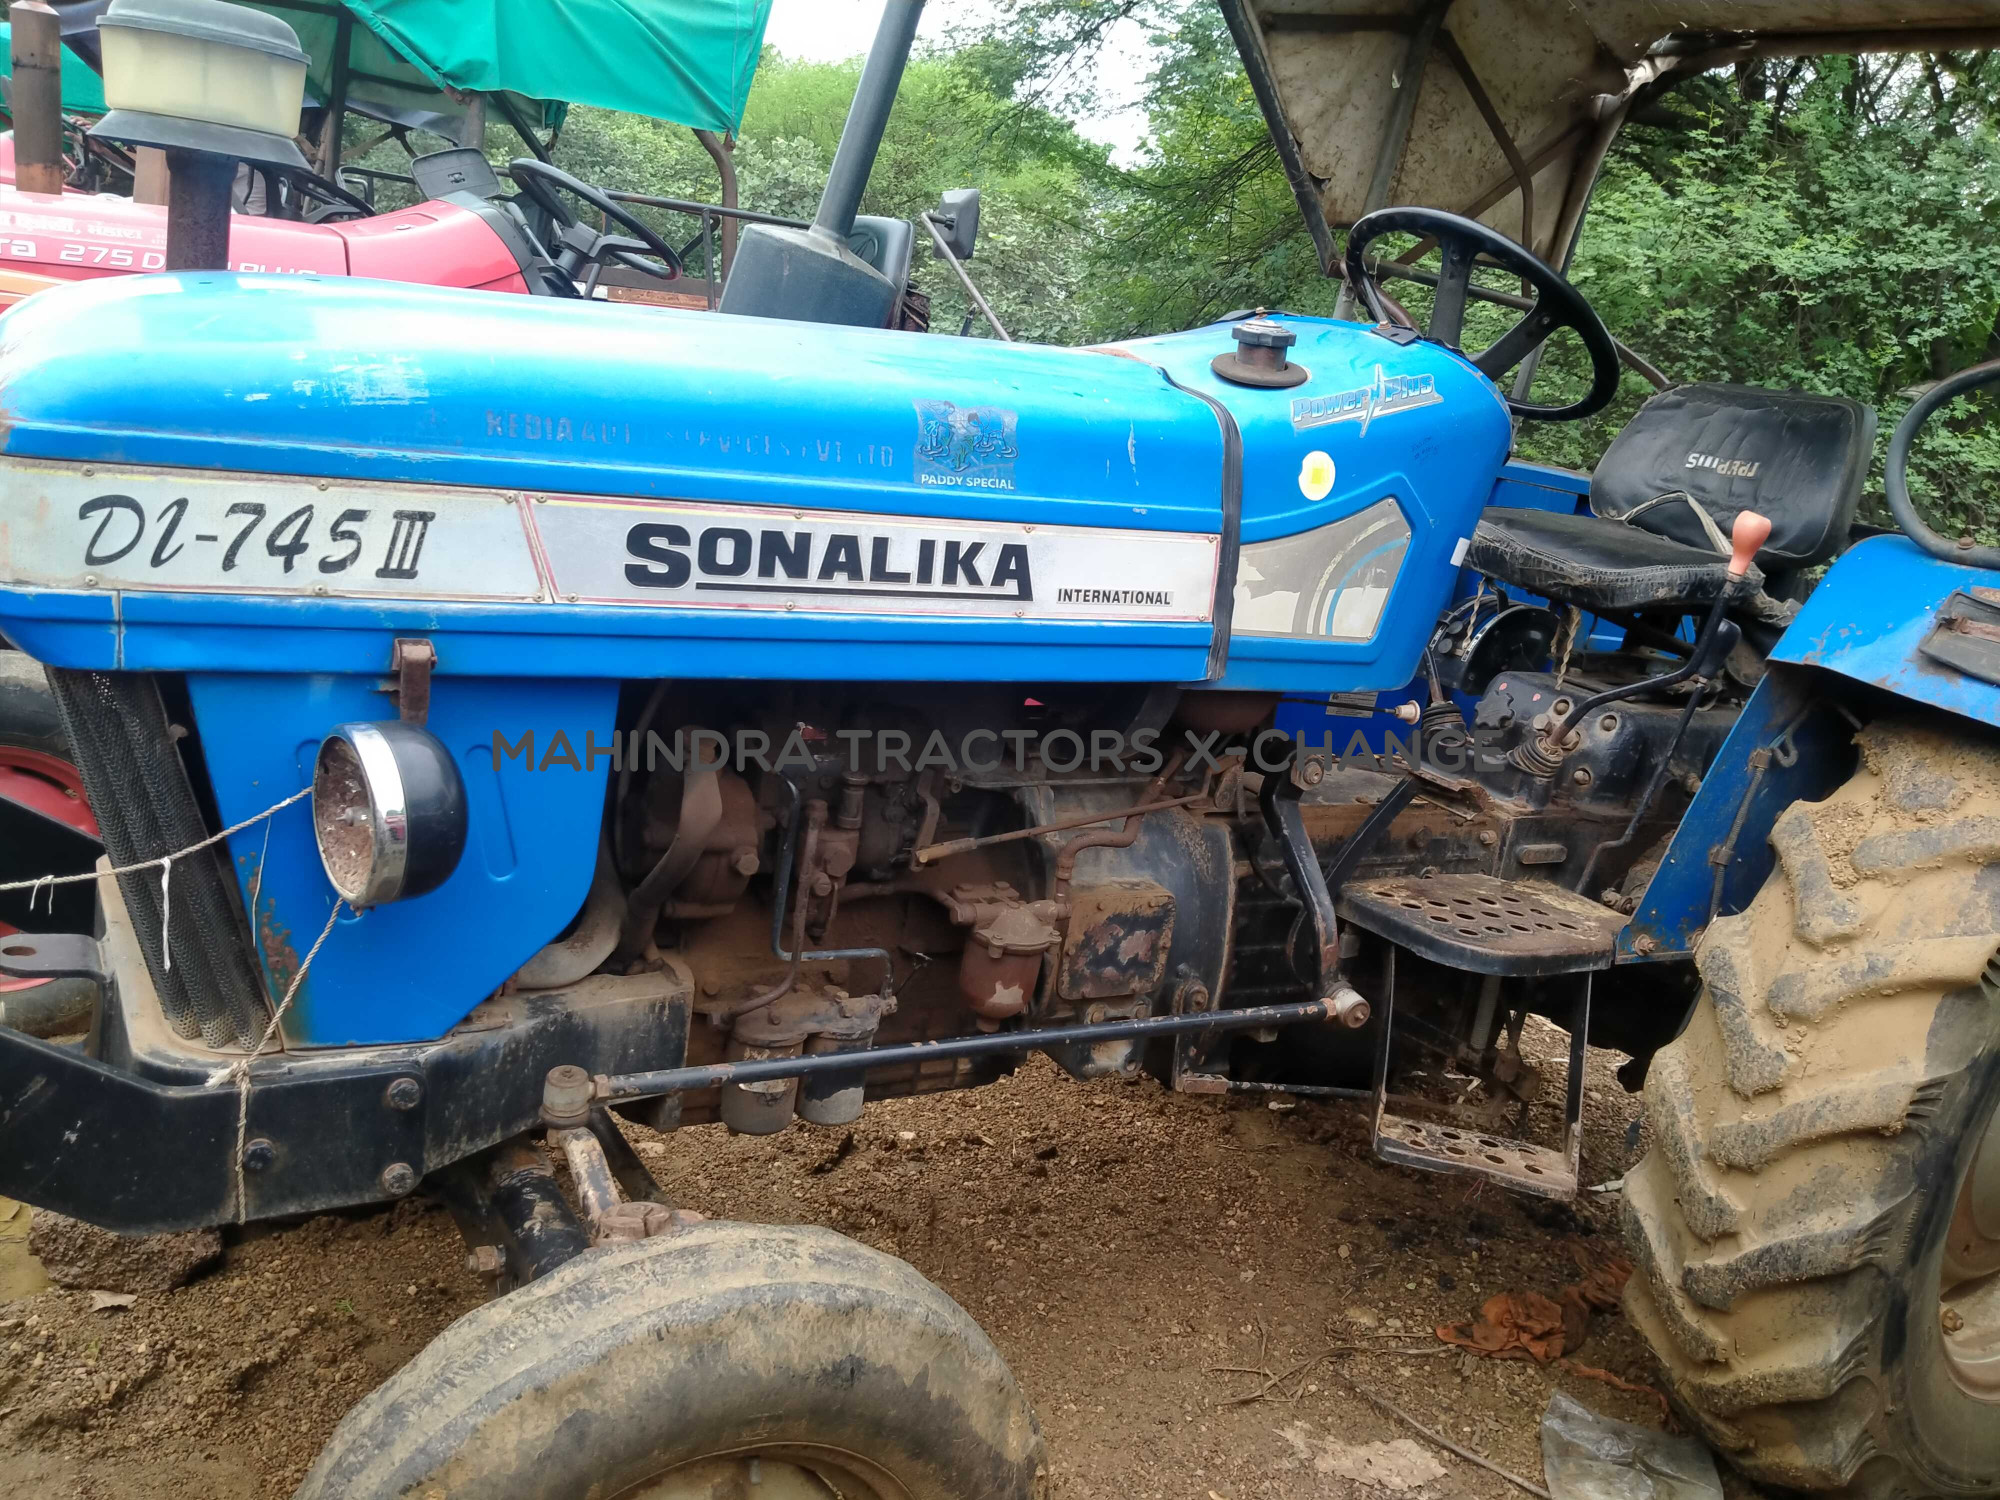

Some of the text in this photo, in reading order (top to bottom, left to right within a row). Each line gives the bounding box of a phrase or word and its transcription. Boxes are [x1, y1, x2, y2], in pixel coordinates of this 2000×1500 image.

[59, 244, 134, 266] 275
[1293, 374, 1434, 422] Power Plus
[921, 474, 1015, 490] PADDY SPECIAL
[623, 521, 1034, 602] SONALIKA
[1057, 588, 1173, 606] INTERNATIONAL
